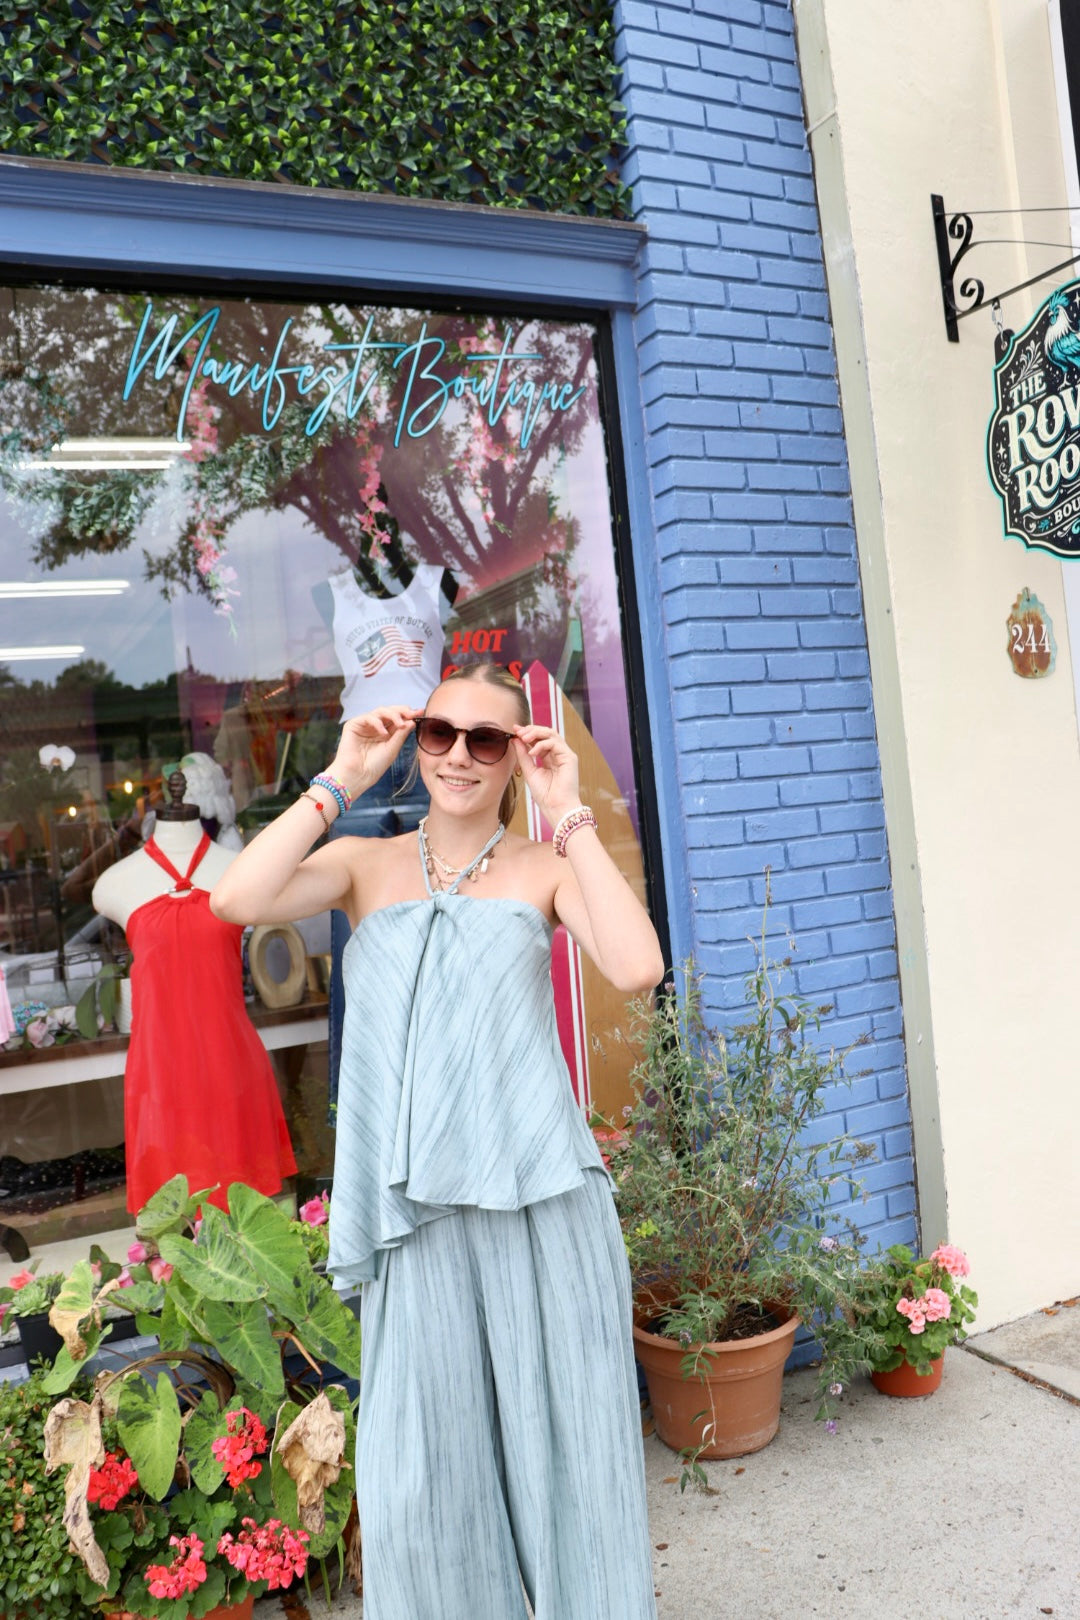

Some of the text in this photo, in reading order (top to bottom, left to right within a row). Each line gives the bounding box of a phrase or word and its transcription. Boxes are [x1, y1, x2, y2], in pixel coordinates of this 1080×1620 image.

[124, 303, 587, 449] Manifest Boutique
[1009, 371, 1047, 409] THE
[1015, 443, 1080, 513] ROO
[450, 628, 508, 654] HOT
[1012, 623, 1051, 653] 244
